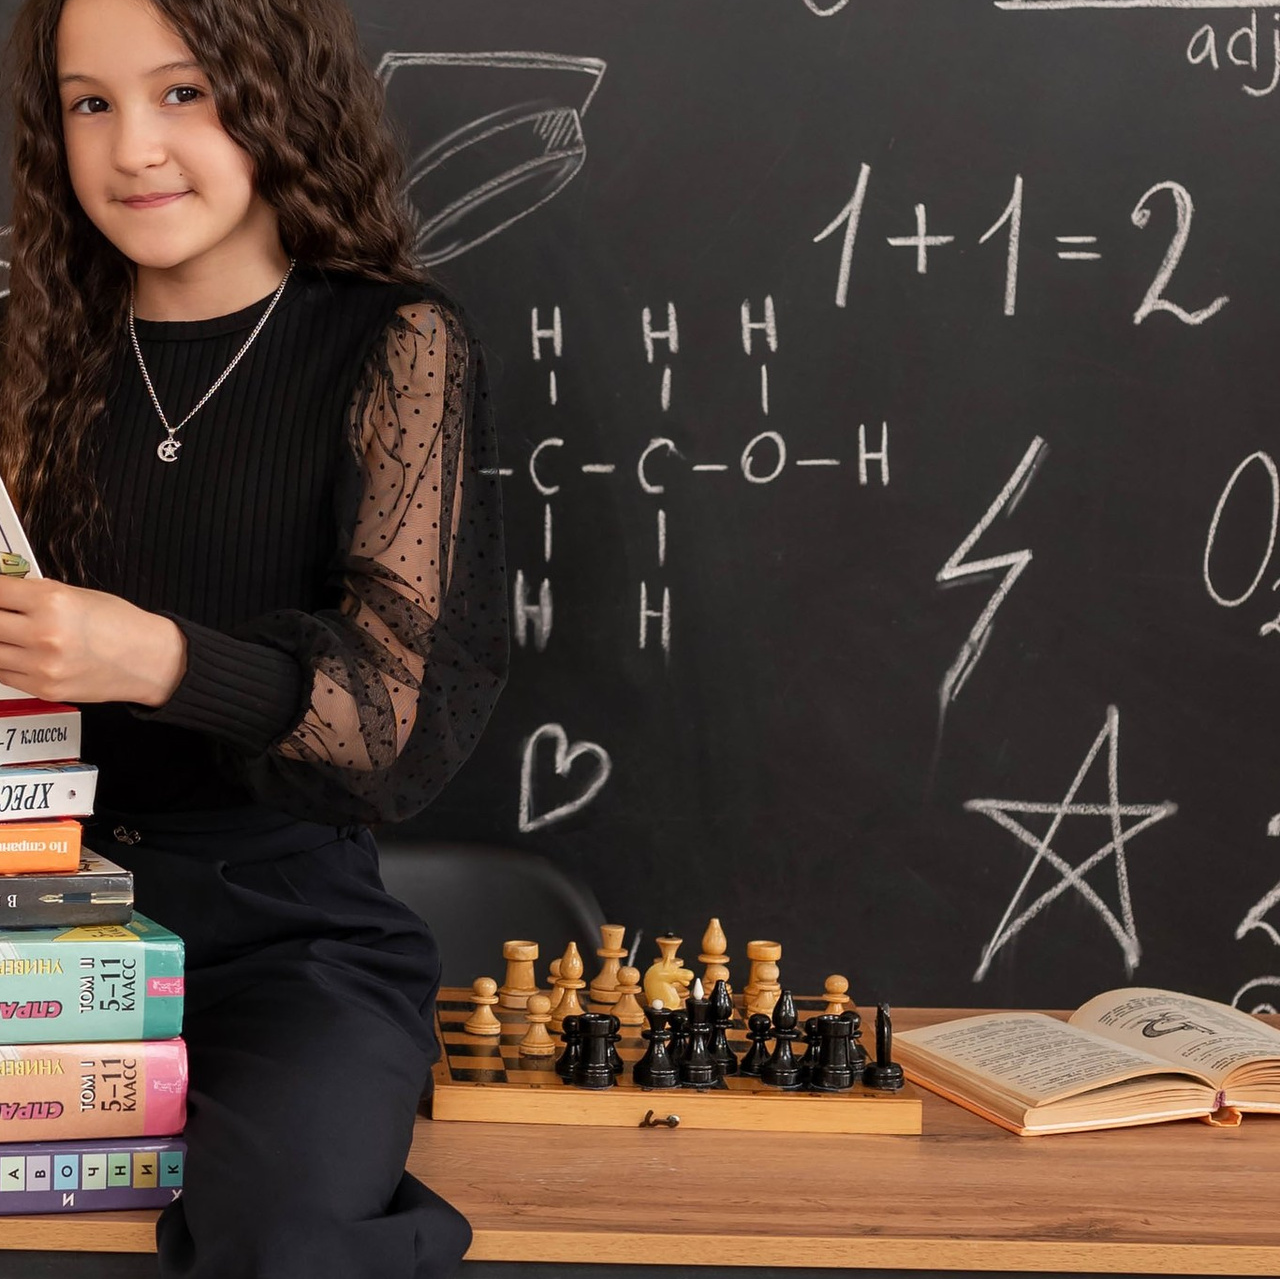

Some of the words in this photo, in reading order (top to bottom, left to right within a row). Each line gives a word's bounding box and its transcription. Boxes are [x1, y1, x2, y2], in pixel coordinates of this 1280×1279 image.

[1187, 10, 1280, 96] adj
[20, 725, 67, 745] классы
[39, 841, 67, 854] По
[7, 894, 18, 908] В
[80, 975, 96, 1013] ТОМ
[121, 958, 137, 1011] КЛАСС
[80, 1073, 96, 1112] ТОМ
[122, 1058, 138, 1112] КЛАСС
